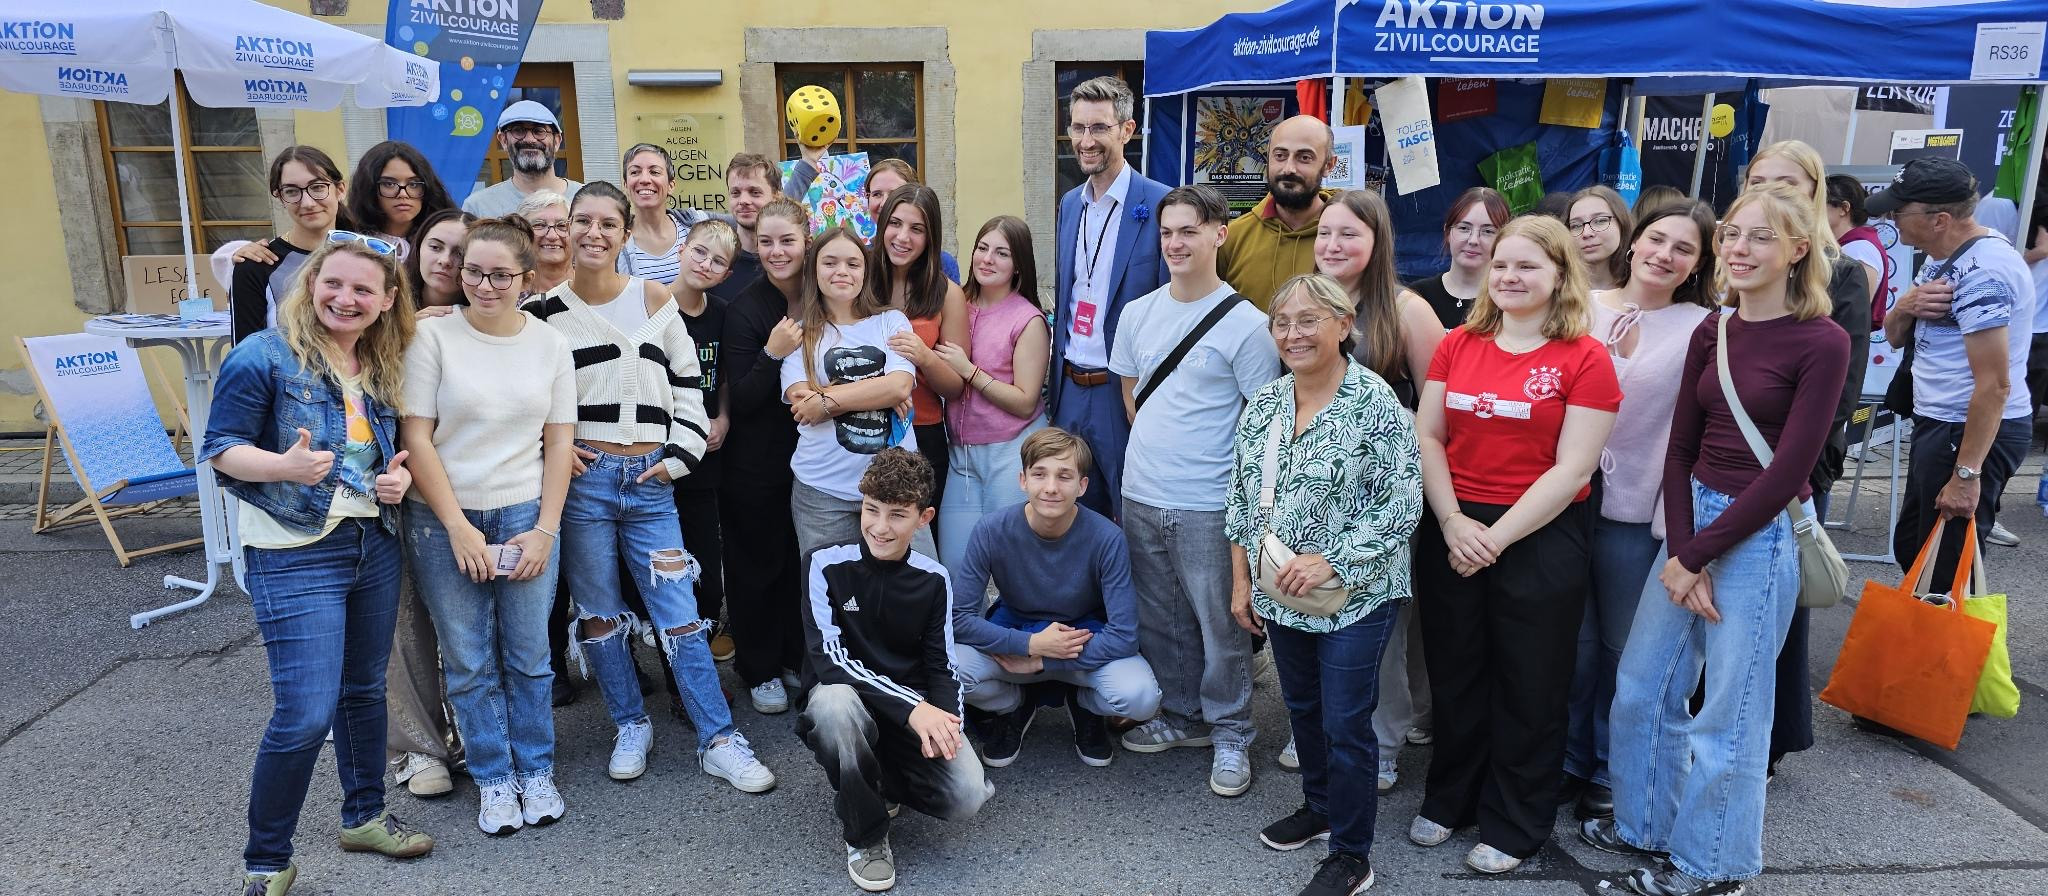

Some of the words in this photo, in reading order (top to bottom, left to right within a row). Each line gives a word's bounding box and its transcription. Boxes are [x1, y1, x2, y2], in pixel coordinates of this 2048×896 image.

[410, 10, 519, 36] ZIVILCOURAGE
[1233, 25, 1321, 57] aktion-zivilcourage.de
[1374, 32, 1540, 53] ZIVILCOURAGE
[235, 52, 315, 68] ZIVILCOURAGE
[1989, 45, 2029, 61] RS36
[1643, 117, 1713, 141] MACHE
[666, 136, 699, 145] AUGEN
[669, 149, 708, 161] UGEN
[56, 362, 121, 377] ZIVILCOURAGE
